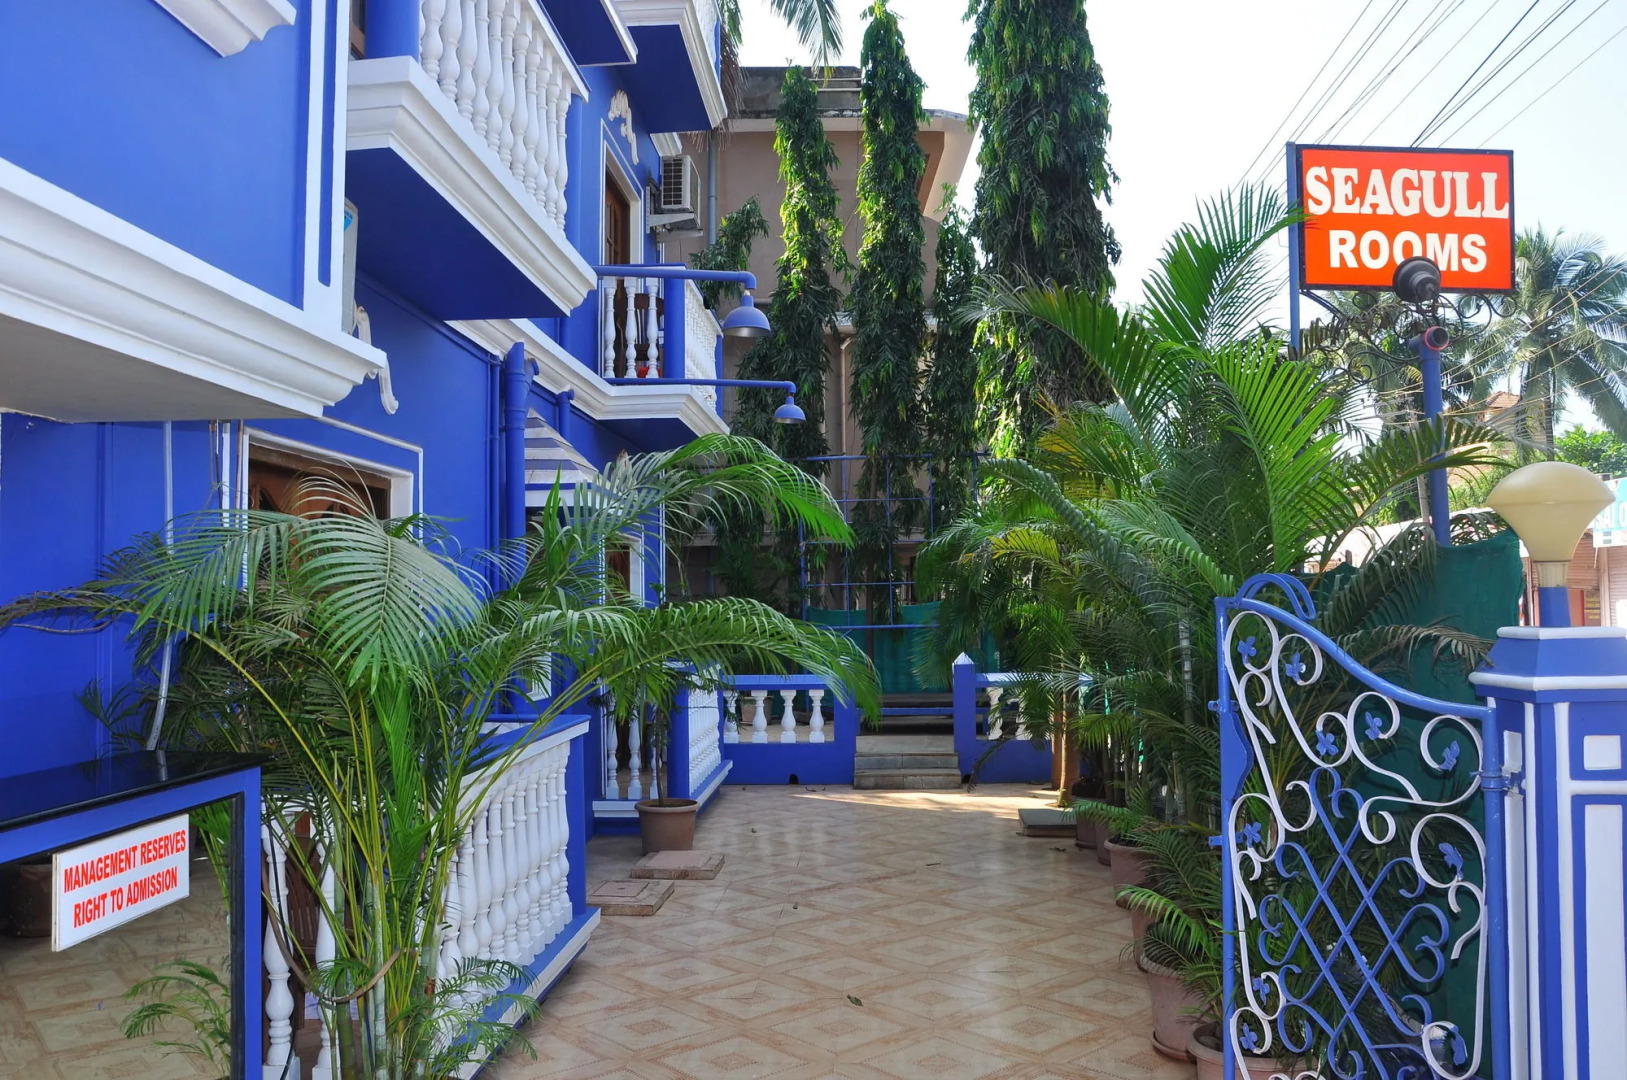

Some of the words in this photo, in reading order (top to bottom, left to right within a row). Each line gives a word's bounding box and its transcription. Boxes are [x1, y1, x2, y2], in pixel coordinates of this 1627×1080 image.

[1305, 166, 1509, 218] SEAGULL
[1328, 230, 1487, 273] ROOMS
[64, 845, 138, 893] MANAGEMENT
[140, 829, 186, 865] RESERVES
[74, 892, 108, 928] RIGHT
[110, 887, 124, 913] TO
[126, 866, 177, 907] ADMISSION
